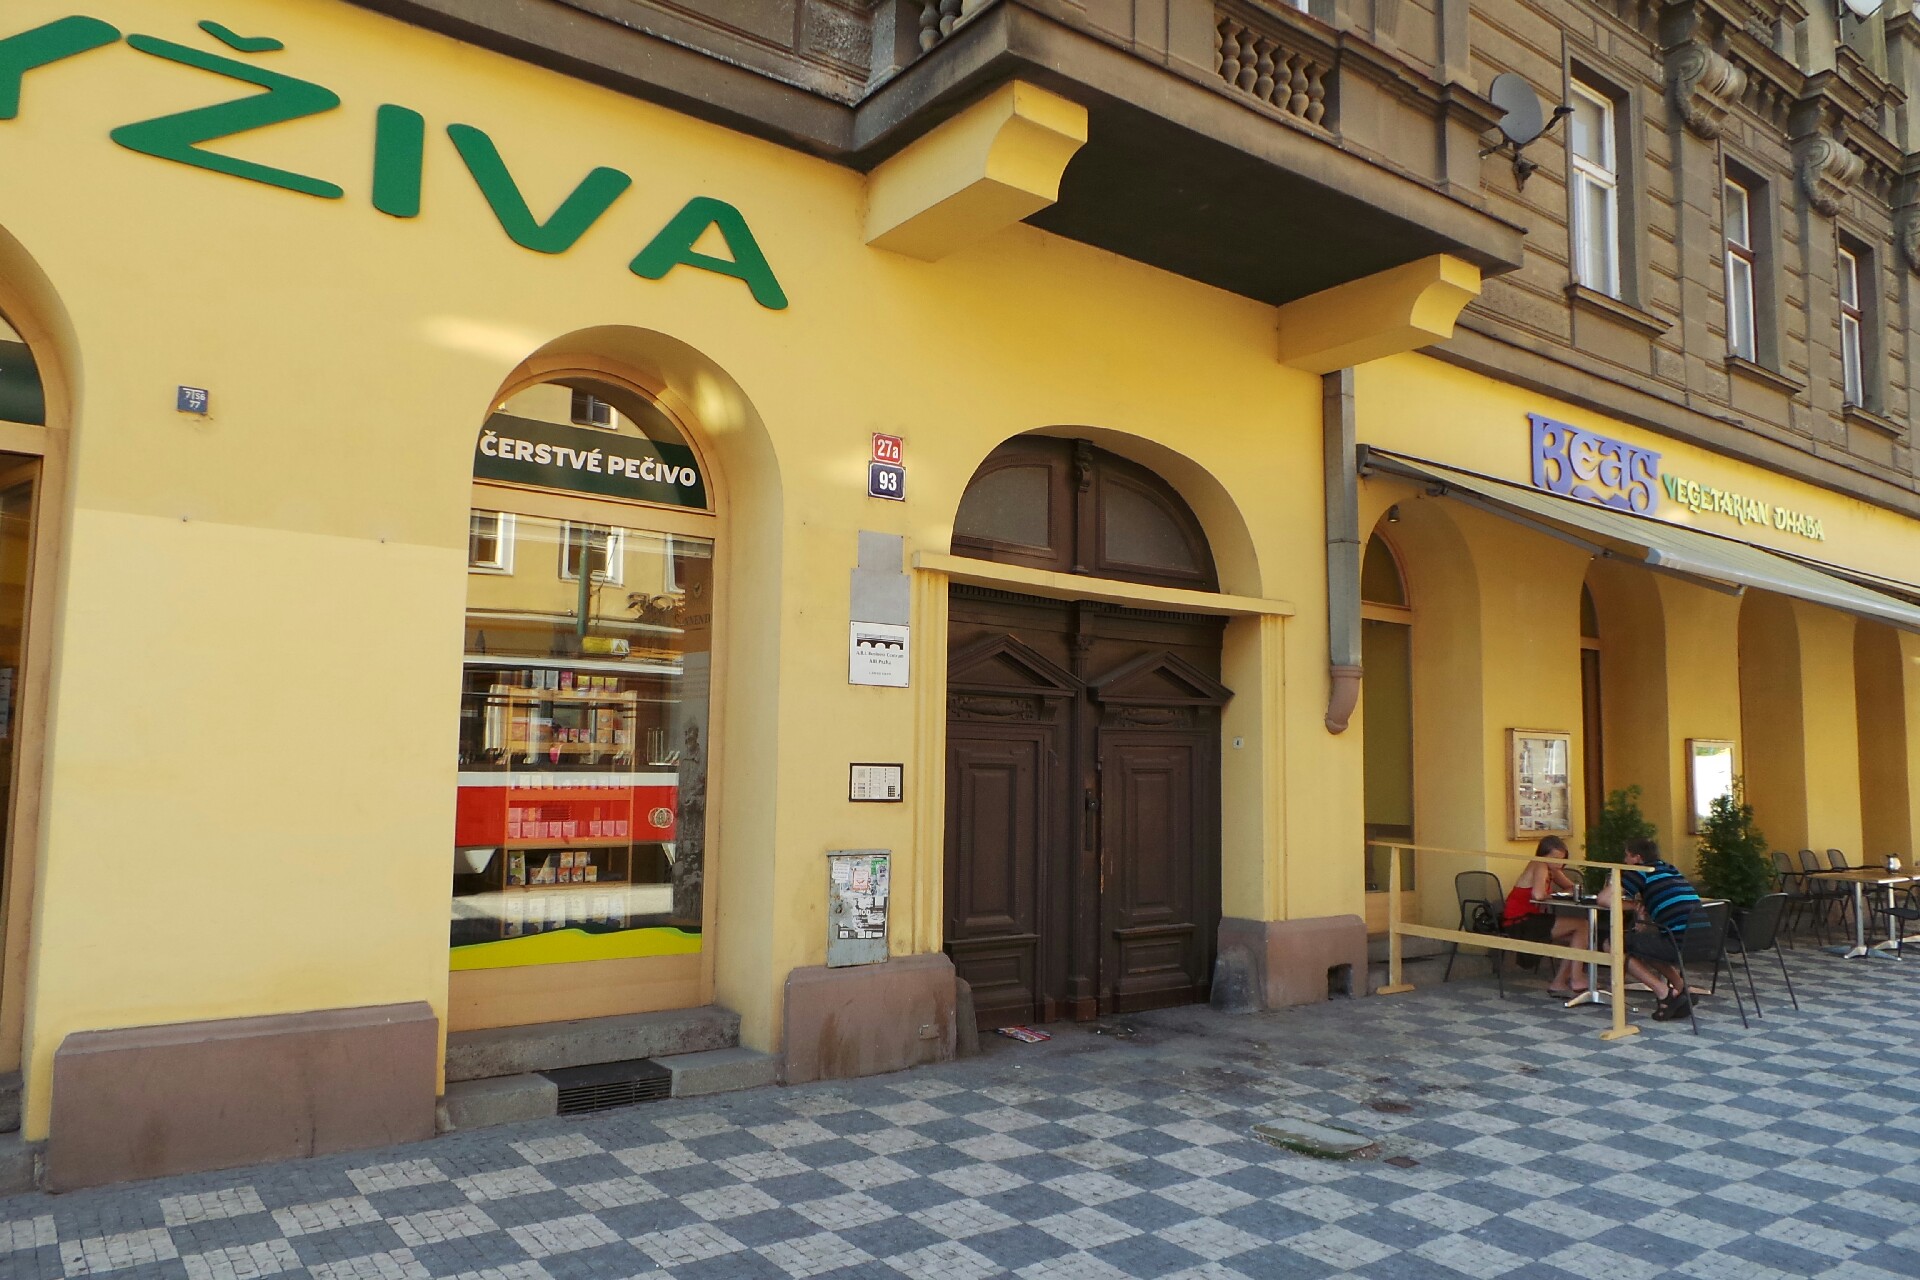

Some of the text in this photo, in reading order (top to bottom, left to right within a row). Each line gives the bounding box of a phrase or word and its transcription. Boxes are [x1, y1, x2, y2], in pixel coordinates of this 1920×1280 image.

[189, 400, 200, 408] 77
[479, 430, 697, 487] ČERSTVÉ PEČIVO
[878, 439, 899, 459] 27a
[879, 471, 897, 491] 93
[1661, 473, 1826, 541] VEGETARIAN DHABA
